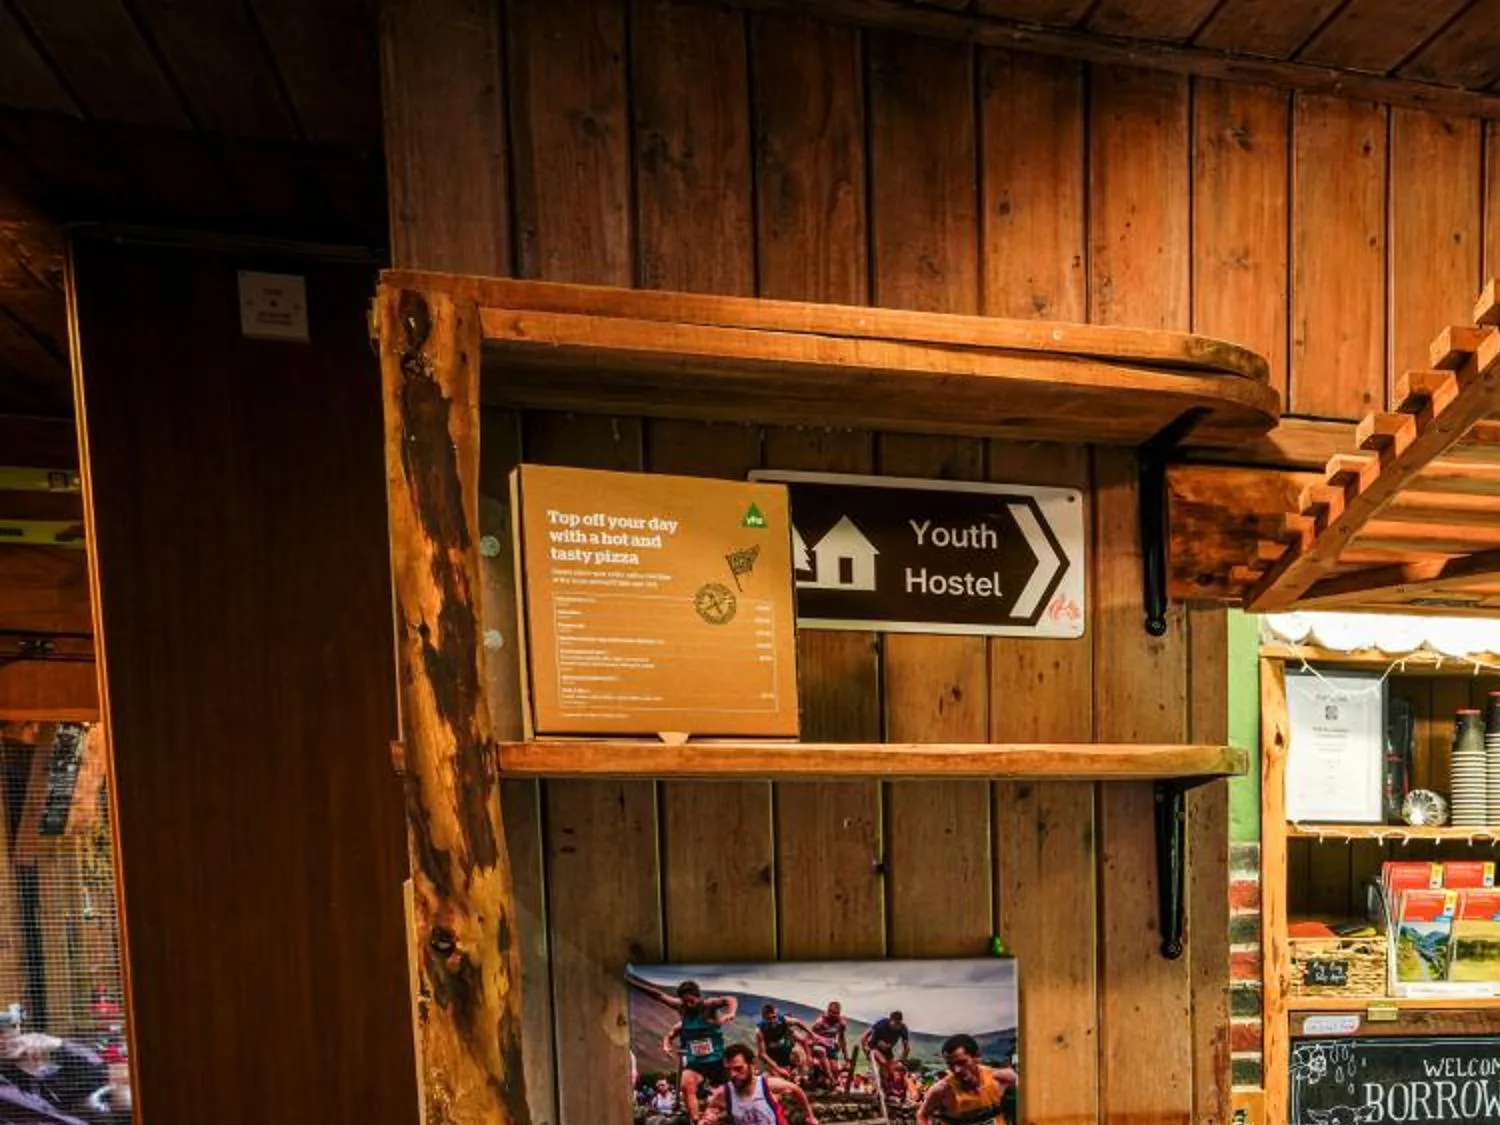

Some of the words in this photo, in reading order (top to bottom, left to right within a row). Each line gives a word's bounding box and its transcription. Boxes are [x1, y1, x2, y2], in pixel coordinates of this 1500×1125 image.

[547, 509, 580, 527] Top
[582, 513, 606, 527] off
[607, 516, 647, 531] your
[648, 518, 679, 535] day
[908, 519, 997, 549] Youth
[549, 529, 588, 544] with
[589, 533, 600, 545] a
[601, 531, 630, 546] hot
[631, 535, 662, 549] and
[550, 547, 592, 564] tasty
[594, 549, 640, 565] pizza
[904, 567, 1003, 597] Hostel
